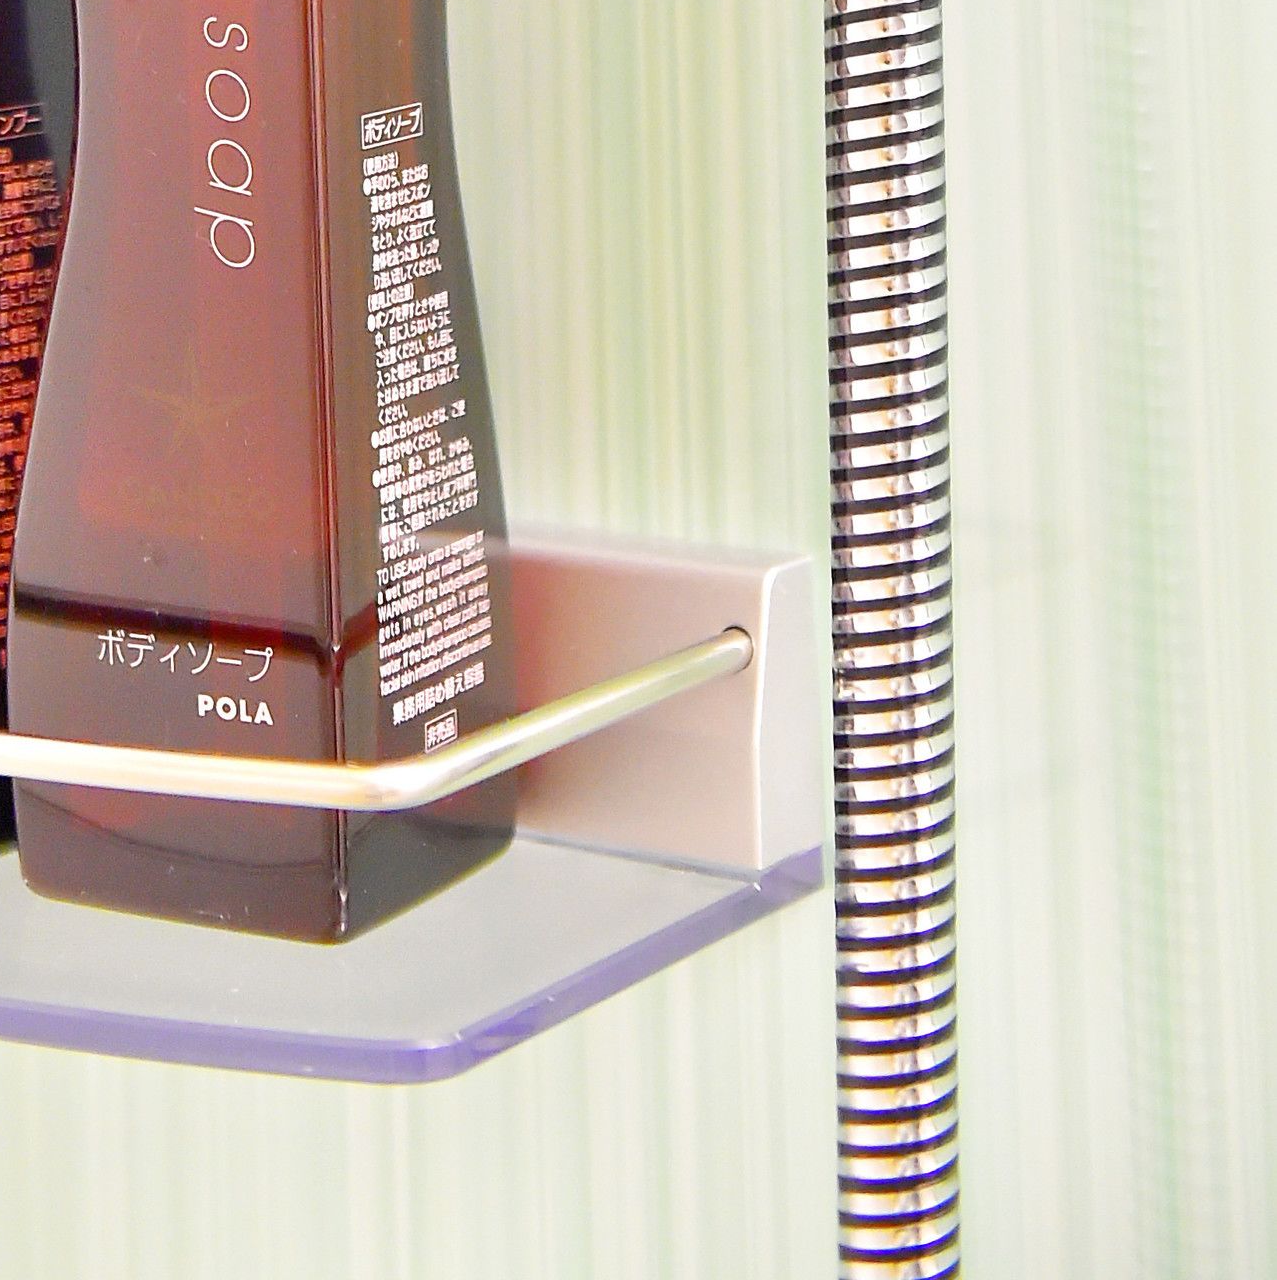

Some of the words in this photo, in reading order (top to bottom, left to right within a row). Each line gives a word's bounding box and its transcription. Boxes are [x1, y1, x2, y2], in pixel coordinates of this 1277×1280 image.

[193, 16, 256, 268] soap
[364, 108, 421, 144] ボディソープ
[377, 568, 389, 586] TO
[385, 583, 401, 602] wet
[379, 621, 401, 644] gets
[403, 616, 412, 632] in
[98, 628, 275, 683] ボディソープ
[197, 693, 275, 727] POLA
